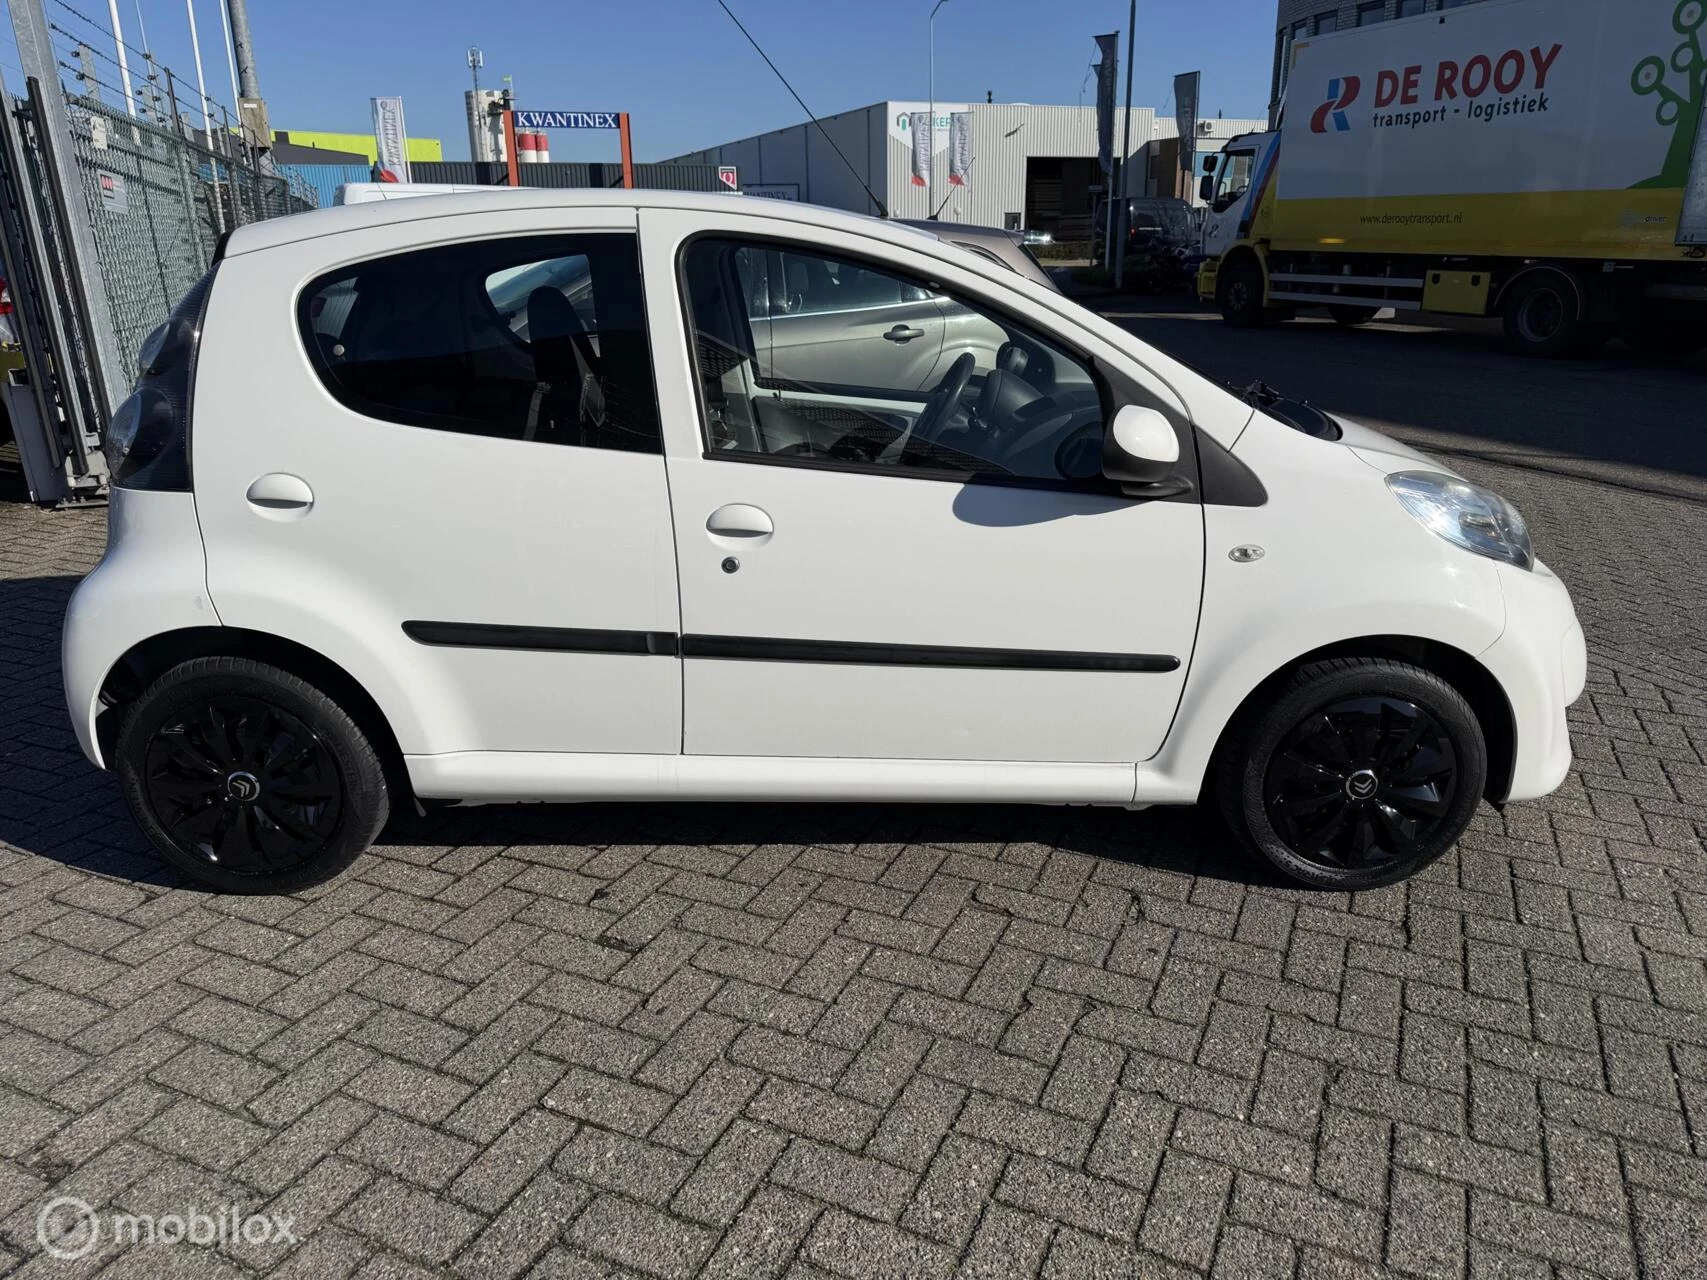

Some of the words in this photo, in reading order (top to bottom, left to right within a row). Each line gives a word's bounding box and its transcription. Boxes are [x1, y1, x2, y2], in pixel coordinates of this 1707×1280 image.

[1374, 65, 1422, 109] DE
[1434, 43, 1563, 101] ROOY
[517, 111, 617, 128] KWANTINEX
[1373, 105, 1447, 129] transport
[1467, 91, 1549, 122] logistiek
[1360, 212, 1463, 227] www.derooytransport.nl
